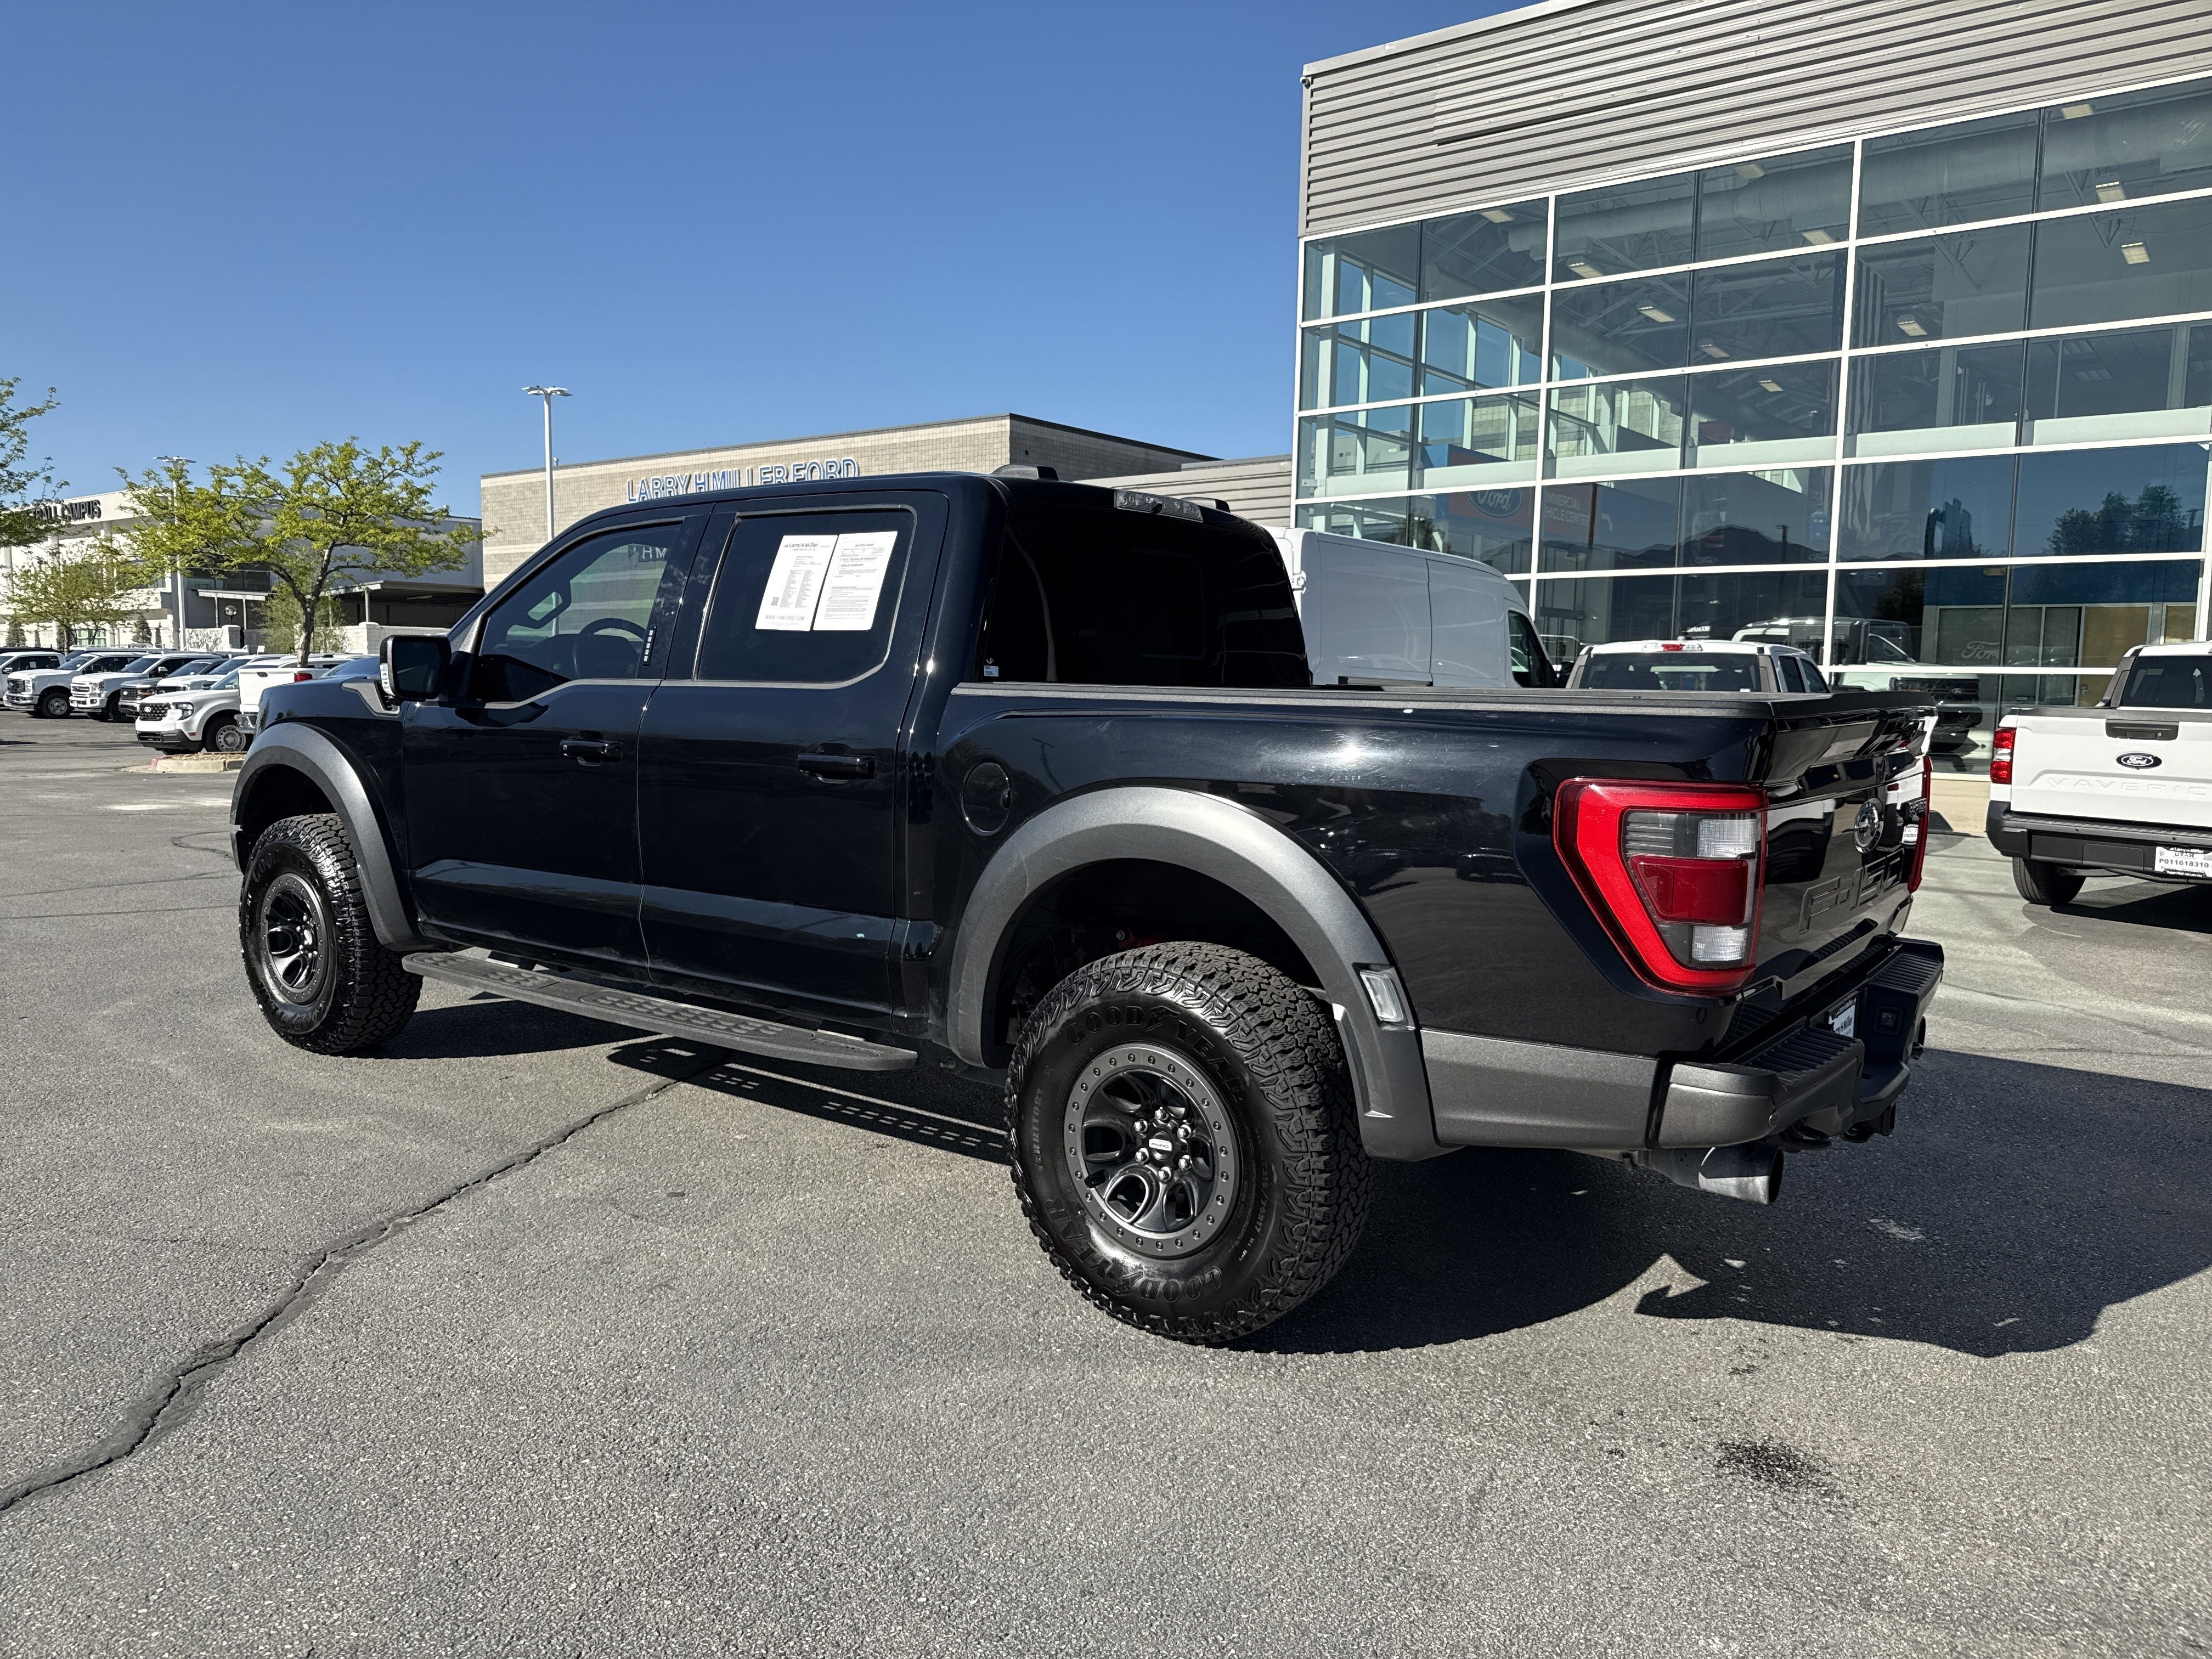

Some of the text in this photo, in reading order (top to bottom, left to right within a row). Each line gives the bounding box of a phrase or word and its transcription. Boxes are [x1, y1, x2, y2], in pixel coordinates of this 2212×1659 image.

[627, 473, 691, 503] LARRY
[694, 471, 709, 493] H
[791, 458, 860, 482] FORD
[60, 500, 101, 521] CAMPUS
[1961, 641, 2000, 659] For
[2159, 858, 2209, 868] P011618310
[1067, 1005, 1247, 1103] GOODYEAR
